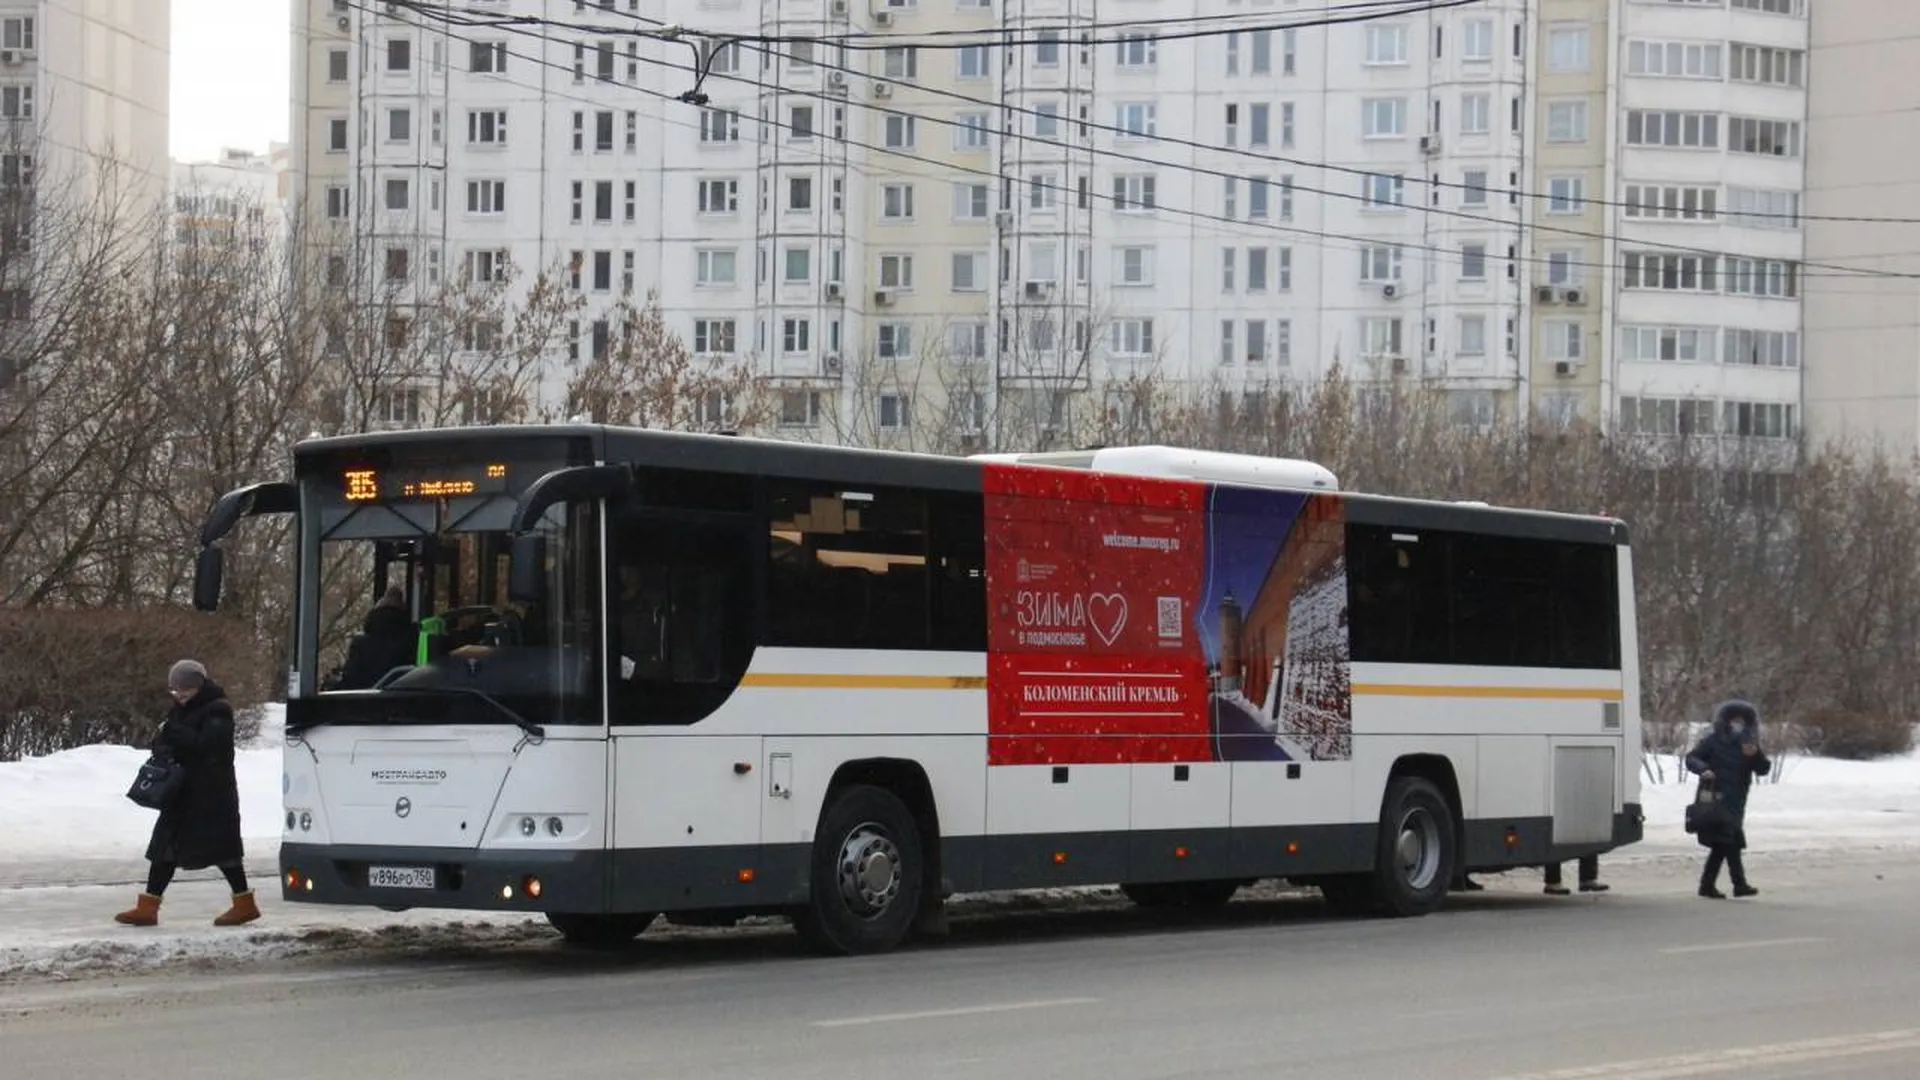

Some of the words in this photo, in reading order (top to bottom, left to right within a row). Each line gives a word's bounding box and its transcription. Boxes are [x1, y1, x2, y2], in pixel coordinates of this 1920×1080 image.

[345, 470, 377, 499] 305
[1023, 682, 1126, 702] КОЛОМЕНСКИЙ
[1129, 685, 1179, 702] КРЕМЛЬ
[371, 770, 447, 780] МОСТРАНСАВТО
